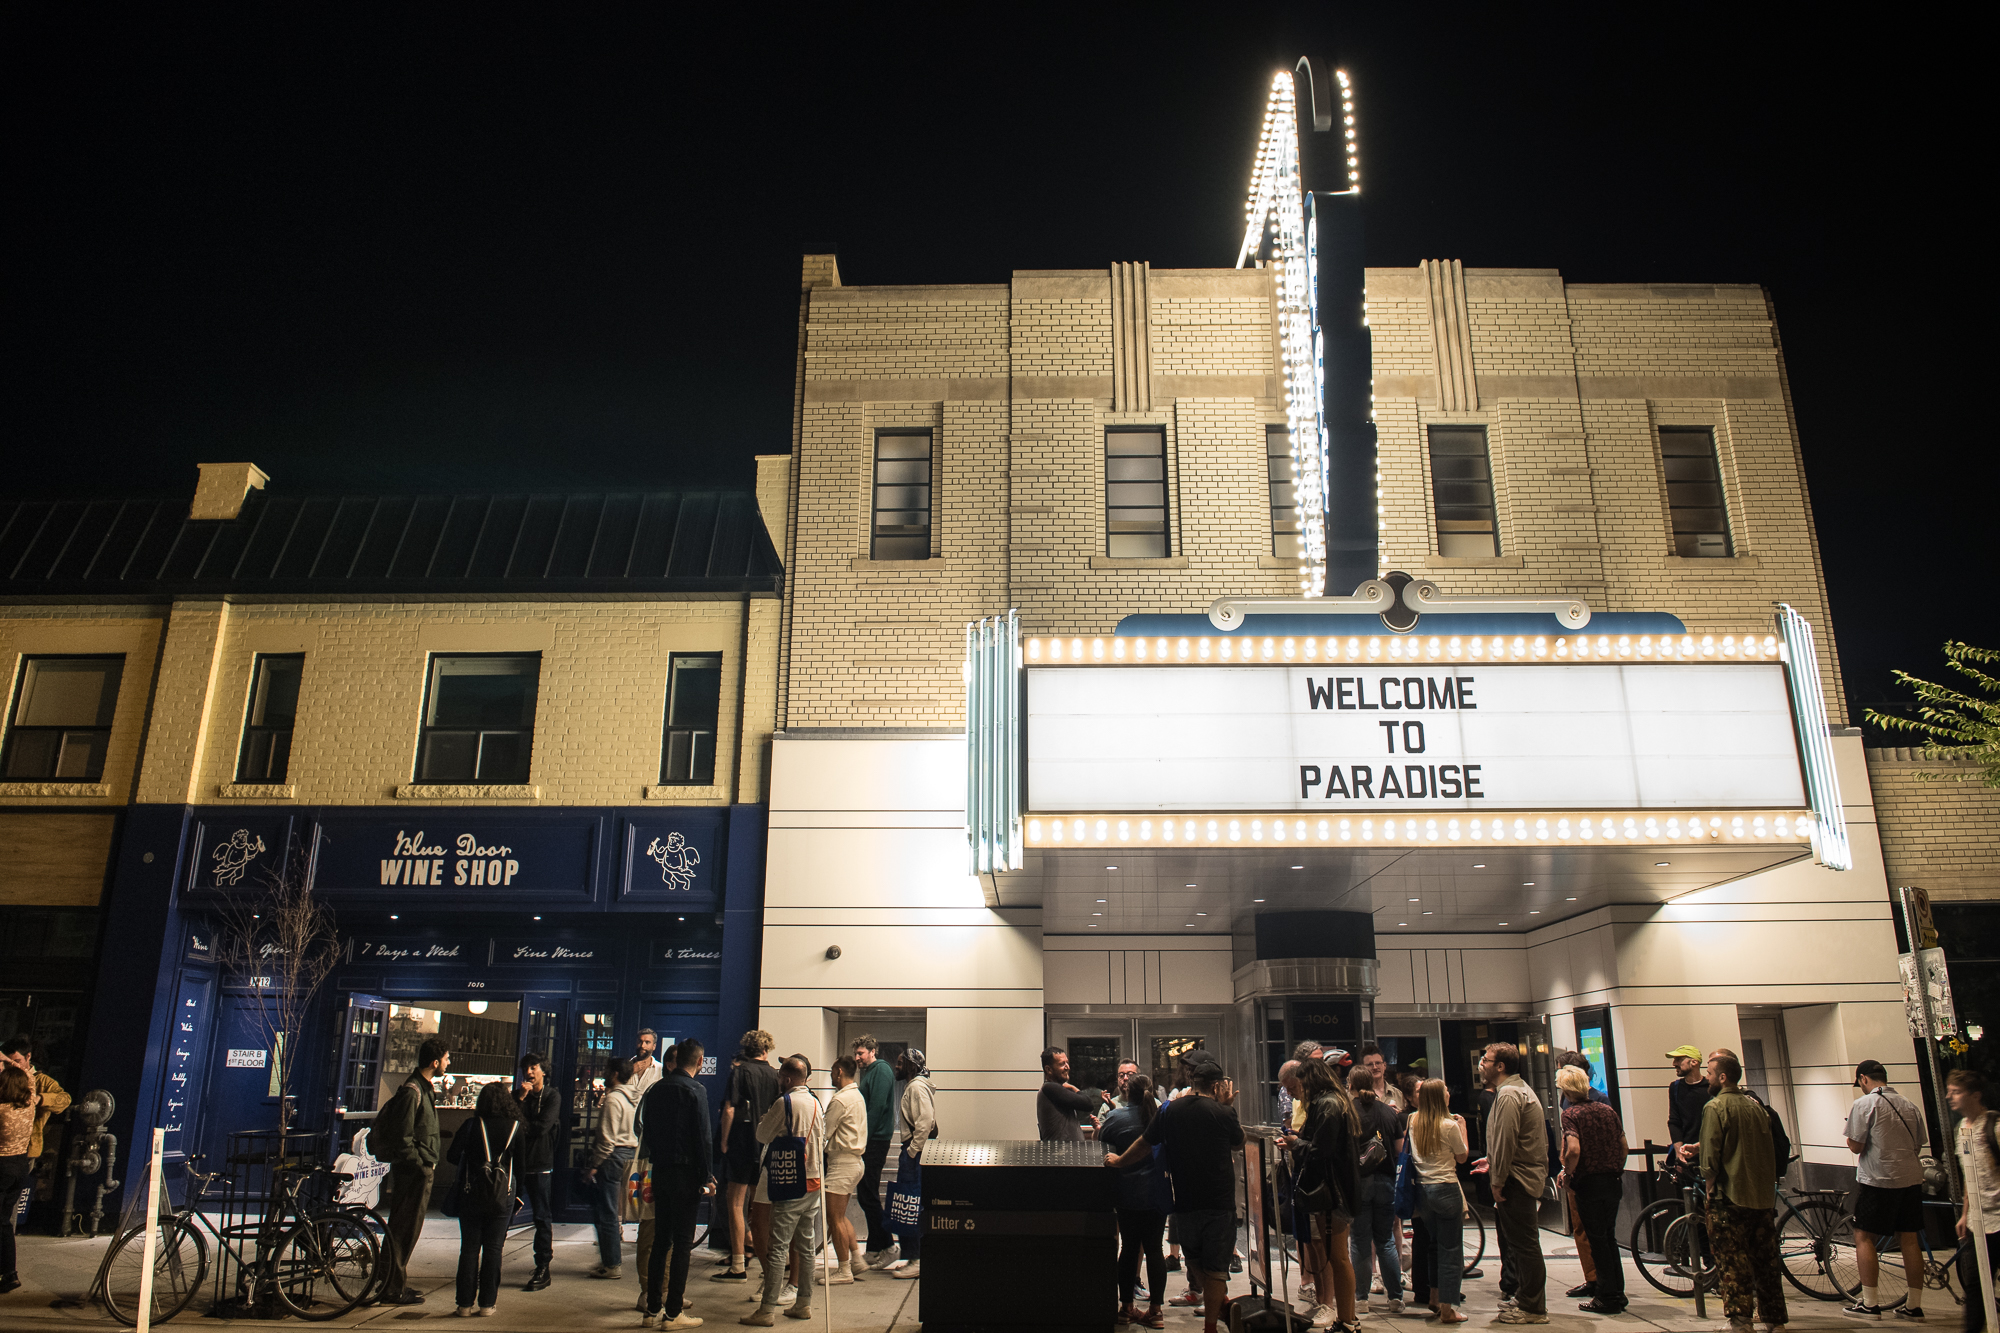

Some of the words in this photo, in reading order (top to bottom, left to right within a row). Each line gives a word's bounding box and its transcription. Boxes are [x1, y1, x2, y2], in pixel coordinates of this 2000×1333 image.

[1306, 677, 1477, 710] WELCOME
[1378, 720, 1426, 754] TO
[1299, 764, 1485, 799] PARADISE
[393, 830, 448, 857] Blue
[456, 833, 512, 857] Door
[380, 859, 444, 886] WINE
[454, 859, 520, 886] SHOP
[361, 942, 372, 955] 7
[375, 944, 409, 961] Days
[425, 944, 460, 958] Week
[513, 945, 548, 959] Fine
[551, 946, 594, 959] Wines
[664, 948, 674, 959] &
[1309, 1014, 1339, 1025] 1006
[232, 1050, 255, 1058] STAIR
[237, 1059, 264, 1067] FLOOR
[771, 1150, 797, 1160] MUBI
[354, 1170, 369, 1180] WINE
[371, 1167, 385, 1177] SHOP
[893, 1192, 921, 1205] MUBI
[931, 1215, 960, 1230] Litter
